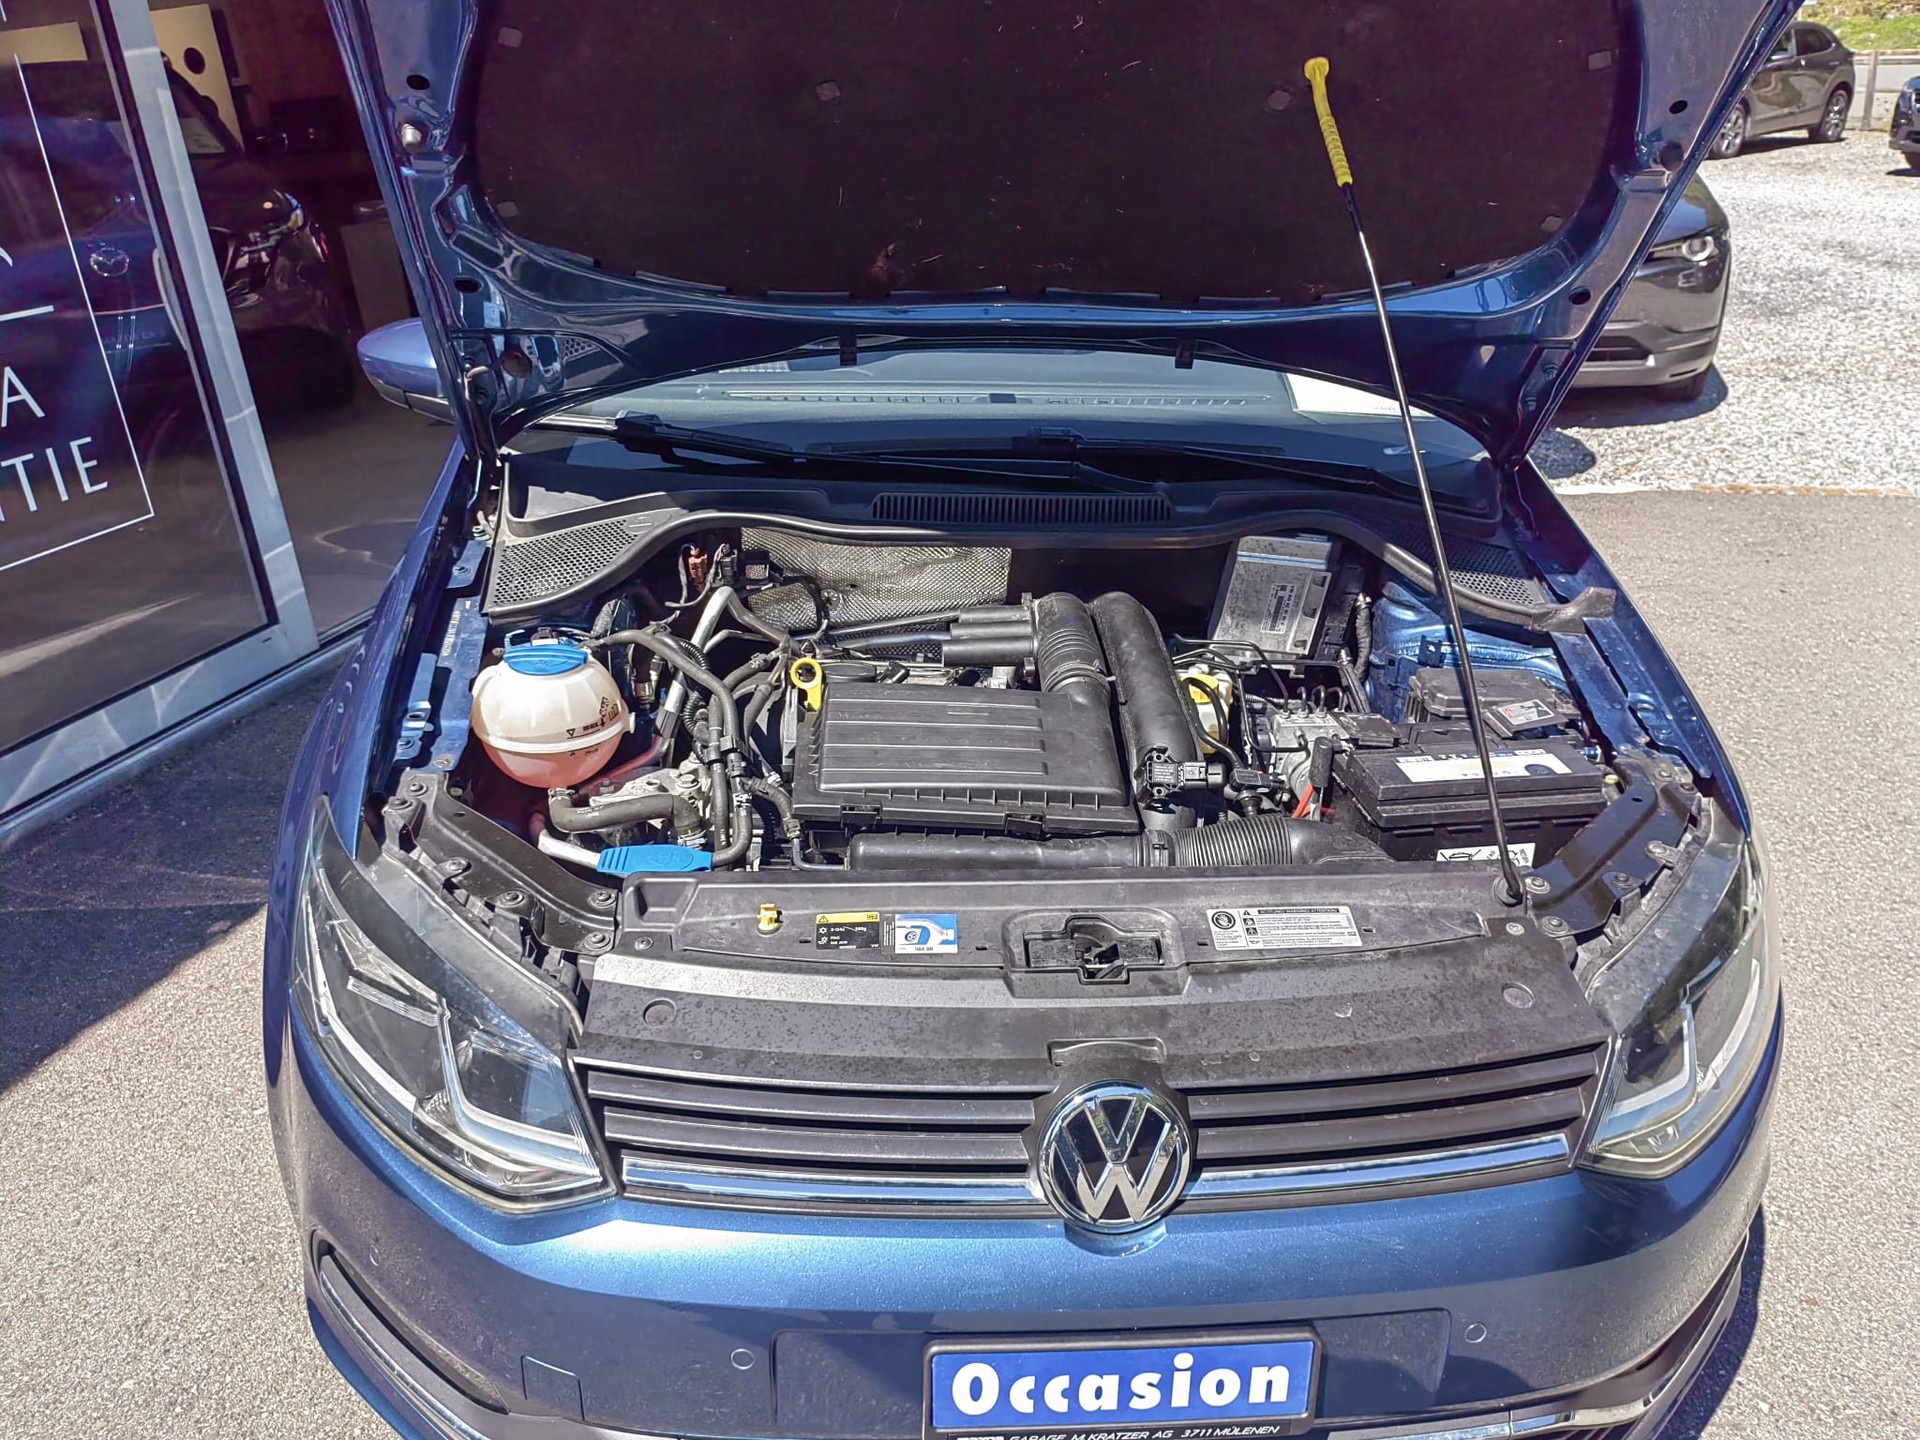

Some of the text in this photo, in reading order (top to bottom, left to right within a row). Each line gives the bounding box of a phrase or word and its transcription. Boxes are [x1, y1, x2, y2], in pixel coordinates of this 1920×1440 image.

[0, 436, 109, 521] TIE
[1049, 1094, 1183, 1225] VW
[950, 1352, 1291, 1417] Occasion
[1151, 1430, 1175, 1439] AG
[1180, 1428, 1213, 1438] 3711
